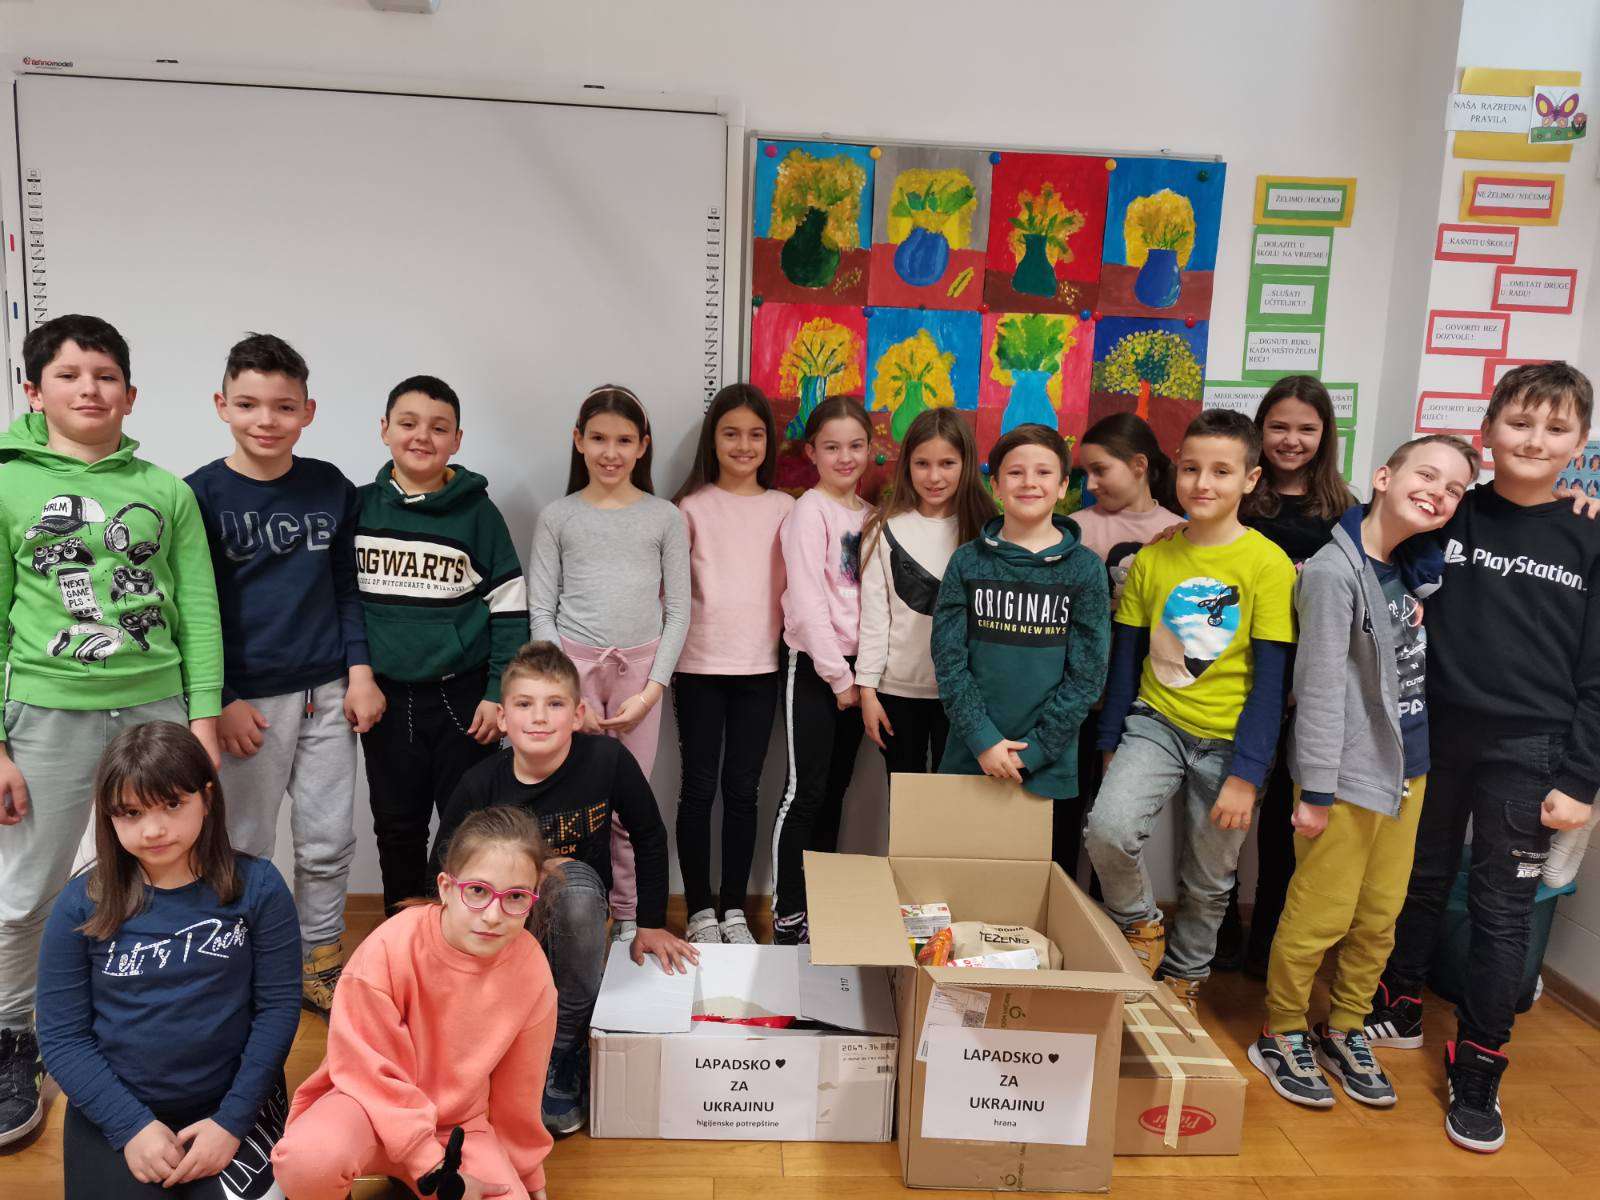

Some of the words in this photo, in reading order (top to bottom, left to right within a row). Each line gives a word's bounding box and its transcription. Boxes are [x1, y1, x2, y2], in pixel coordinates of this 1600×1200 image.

[1453, 100, 1477, 109] NAŠA
[1481, 103, 1527, 112] RAZREDNA
[1470, 114, 1507, 123] PRAVILA
[1249, 347, 1270, 355] KADA
[43, 502, 68, 514] HRLM
[220, 510, 337, 561] UCB
[356, 547, 467, 584] OGWARTS
[1472, 547, 1583, 591] PlayStation
[63, 579, 86, 590] NEXT
[382, 579, 424, 590] WITCHCRAFT
[66, 587, 90, 598] GAME
[68, 598, 84, 608] PLS
[975, 588, 1070, 624] ORIGINALS
[978, 619, 1017, 632] CREATING
[1020, 625, 1042, 634] NEW
[1045, 626, 1067, 635] WAYS
[552, 844, 577, 857] OCK
[979, 931, 1031, 945] TEZENIS
[963, 1048, 1043, 1065] LAPADSKO
[695, 1058, 771, 1071] LAPADSKO
[730, 1081, 749, 1092] ZA
[1000, 1074, 1019, 1087] ZA
[703, 1101, 775, 1112] UKRAJINU
[969, 1097, 1045, 1112] UKRAJINU
[696, 1119, 734, 1128] higijenske
[735, 1120, 780, 1128] potrepštine
[993, 1118, 1017, 1128] hrana
